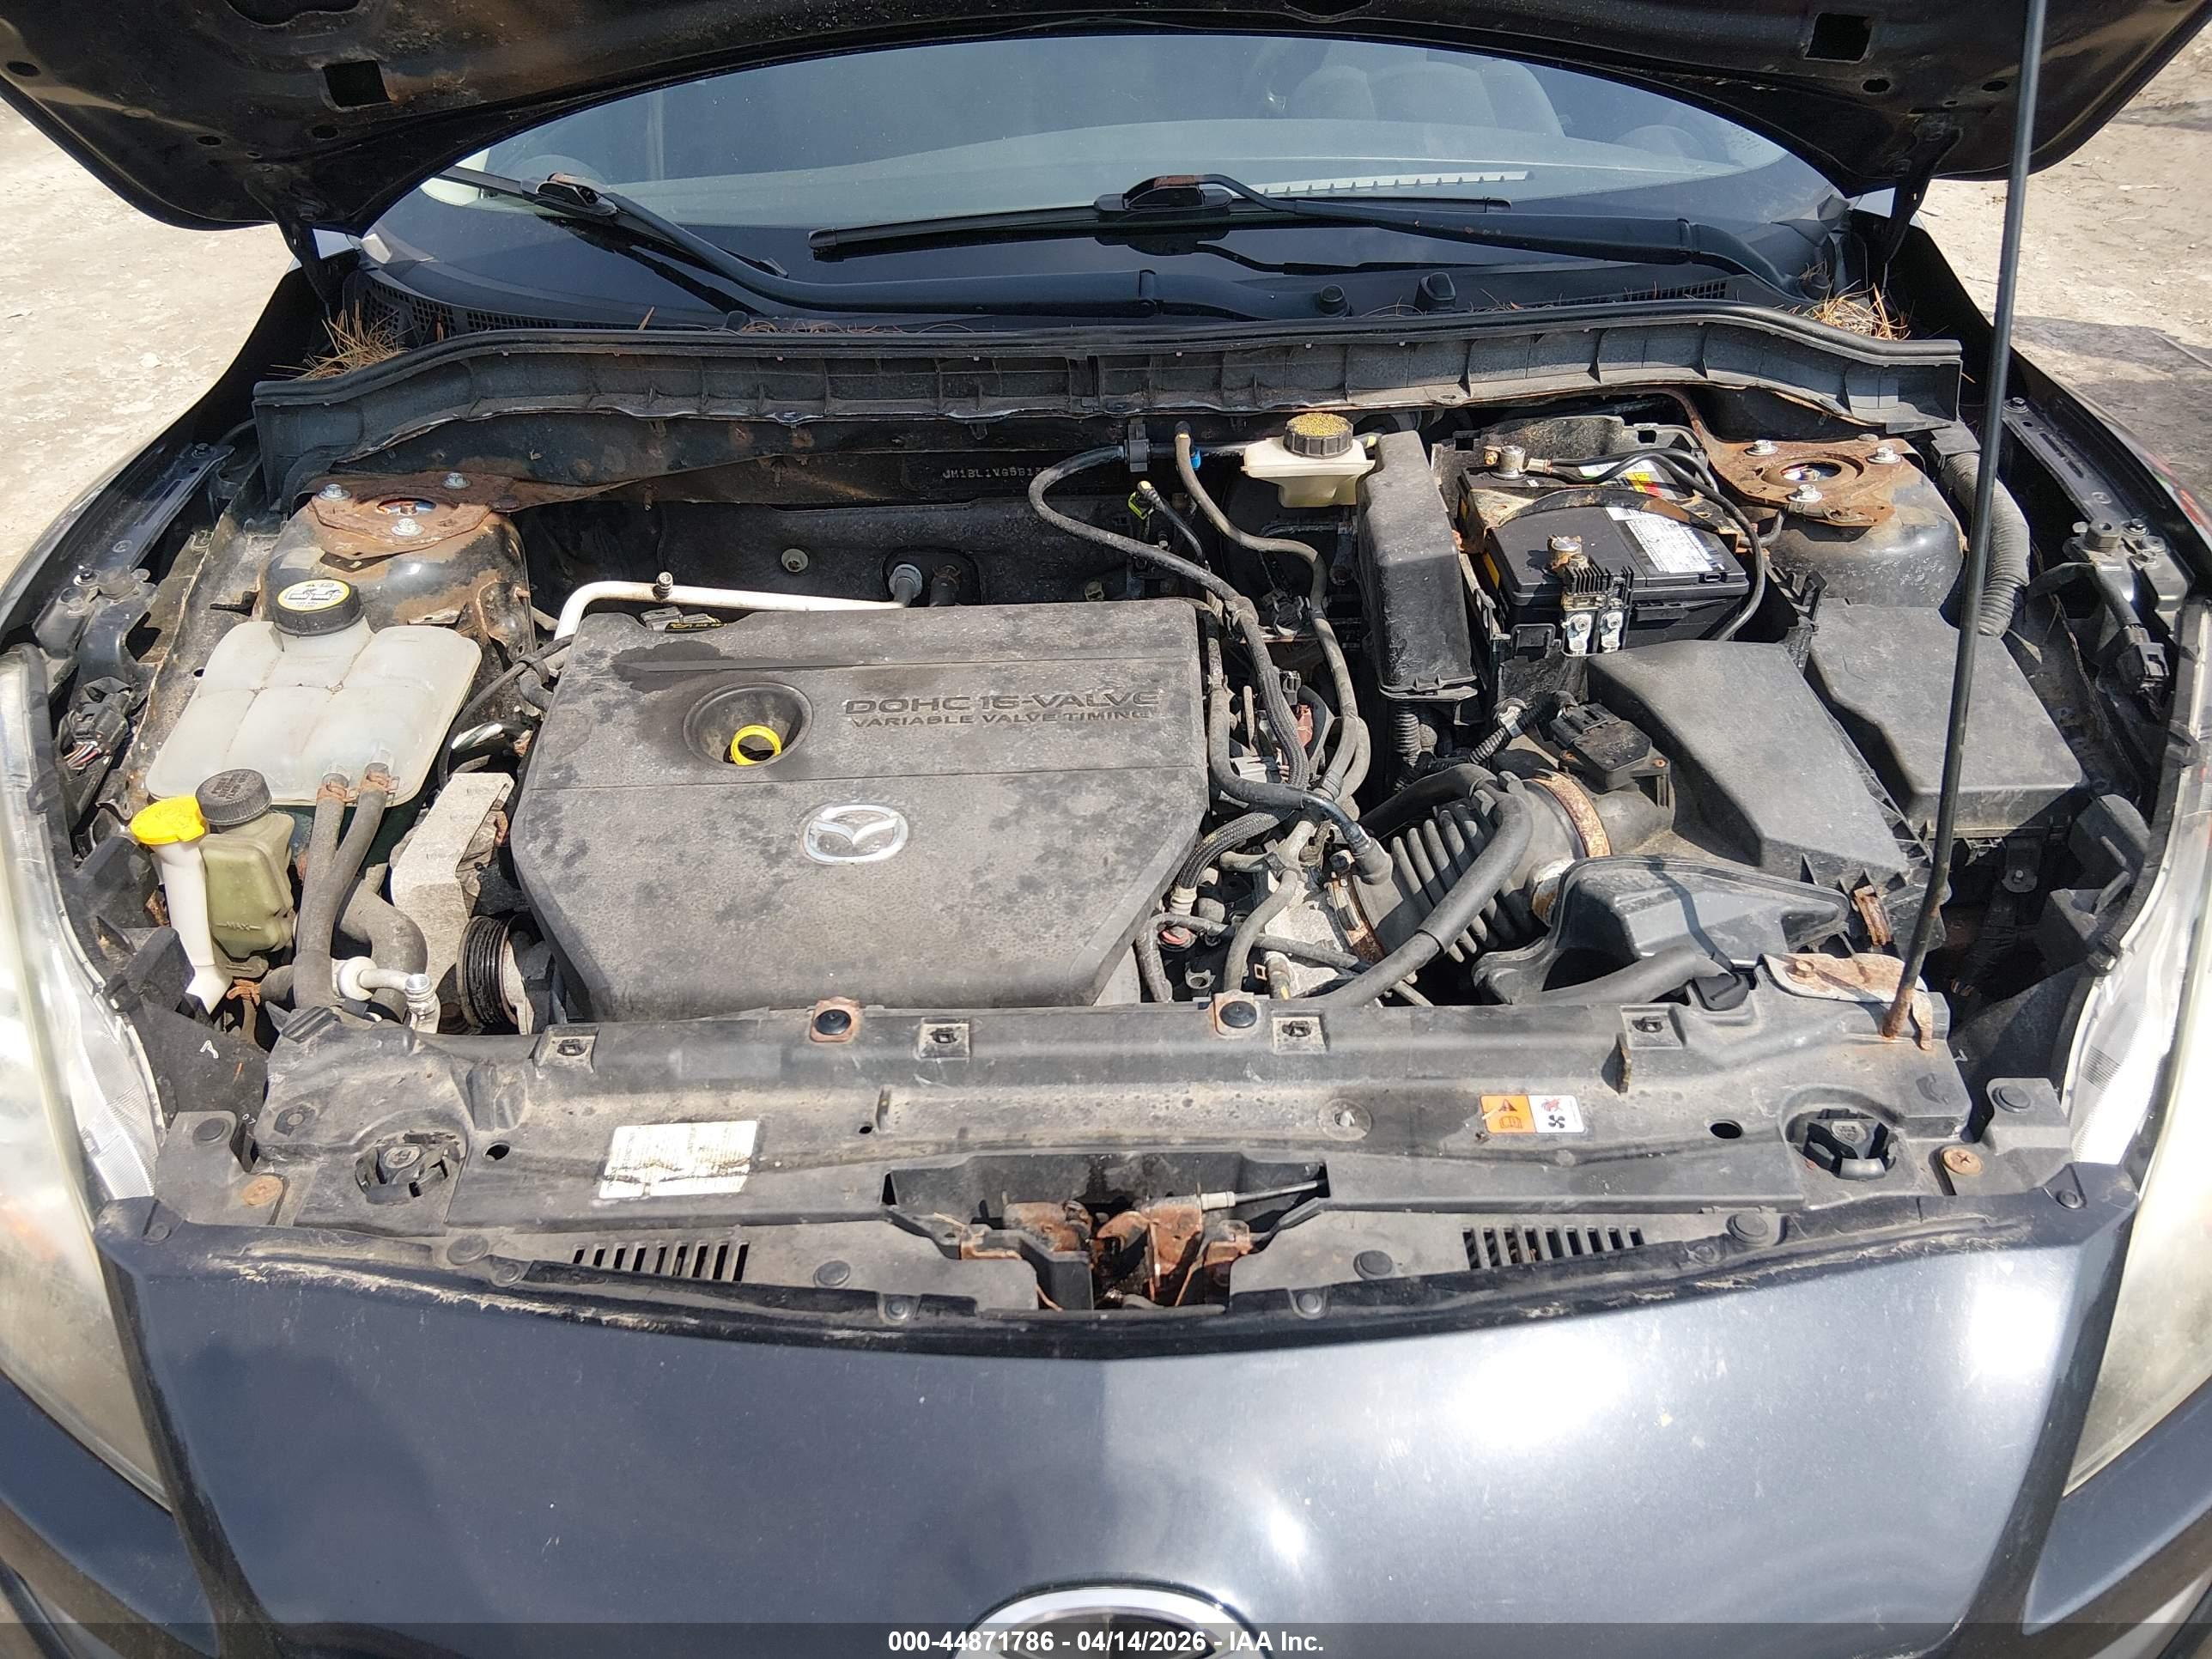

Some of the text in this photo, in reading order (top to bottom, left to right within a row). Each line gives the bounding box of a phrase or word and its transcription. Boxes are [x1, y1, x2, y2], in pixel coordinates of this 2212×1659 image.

[845, 690, 1162, 716] DOHC 16-VALVE
[851, 709, 1151, 728] VARIABLE VALVE TIMING
